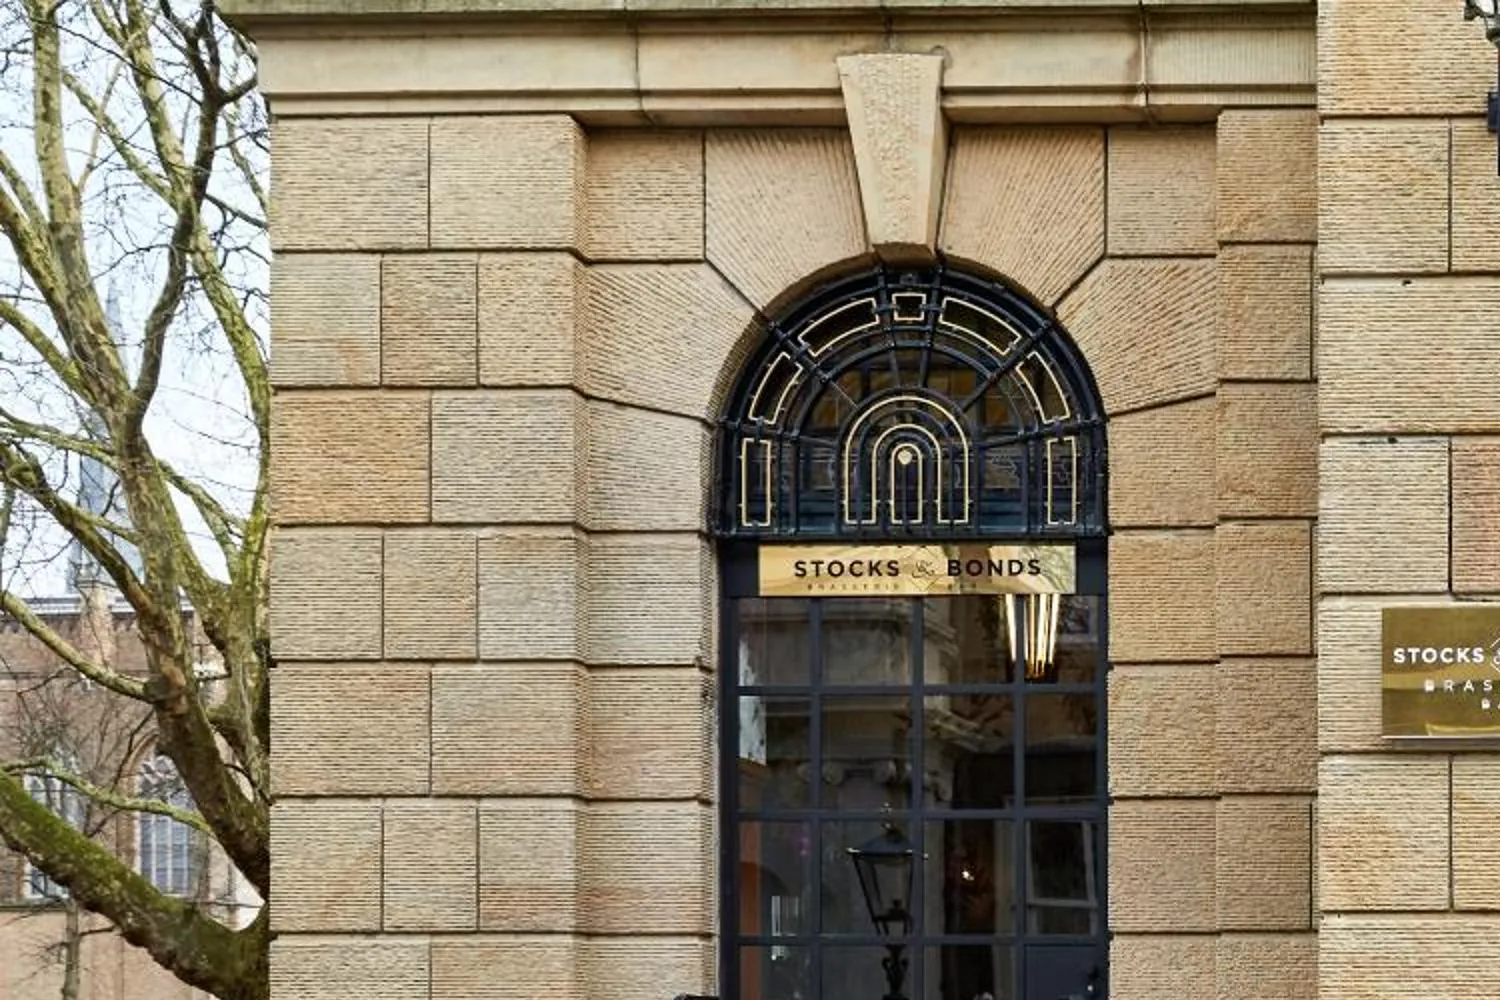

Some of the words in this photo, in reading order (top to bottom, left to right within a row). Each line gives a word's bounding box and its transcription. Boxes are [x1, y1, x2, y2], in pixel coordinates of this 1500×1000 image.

[795, 560, 900, 577] STOCKS
[947, 559, 1041, 577] BONDS
[1393, 647, 1485, 664] STOCKS
